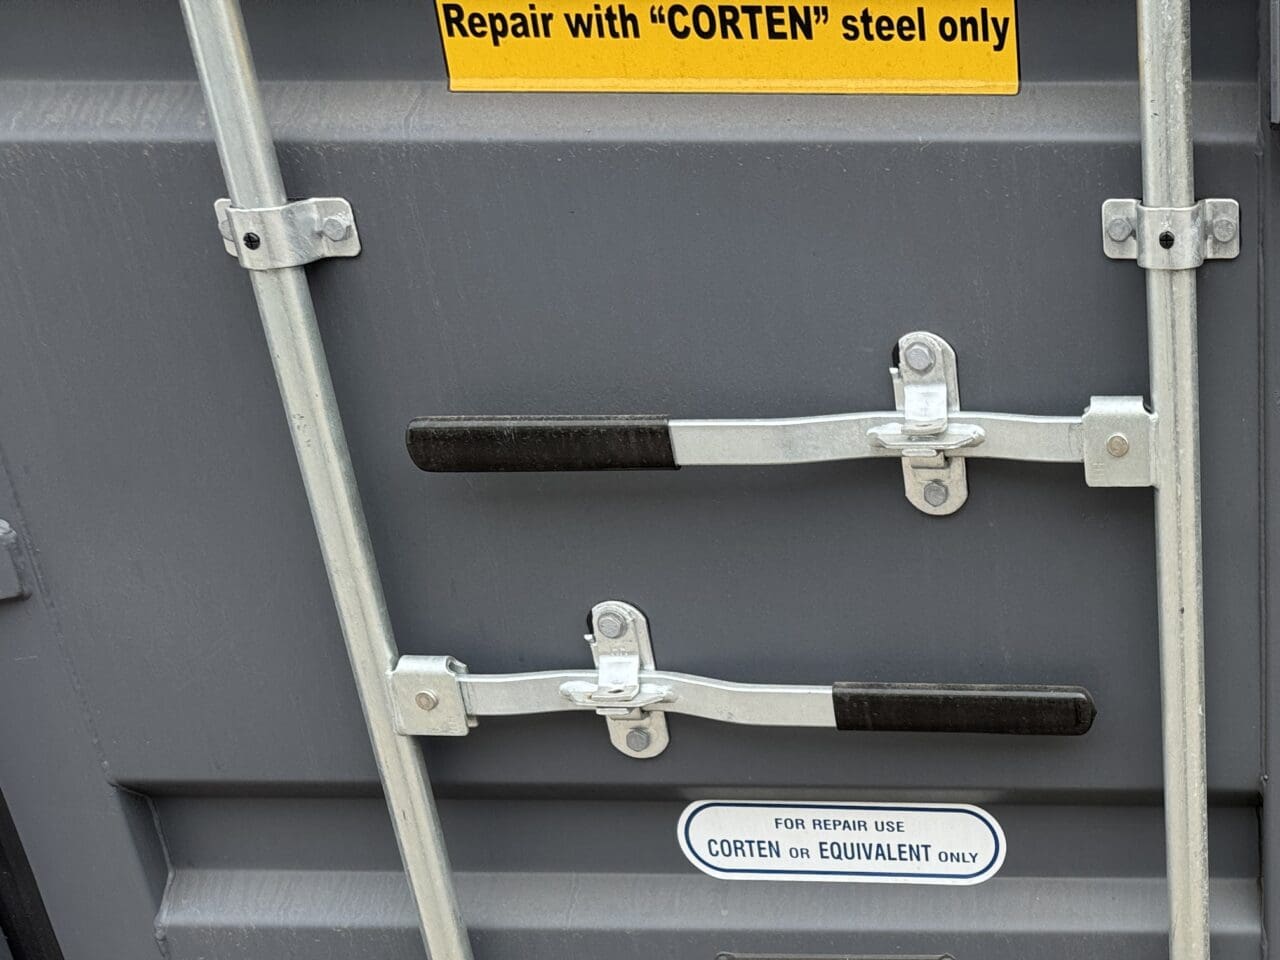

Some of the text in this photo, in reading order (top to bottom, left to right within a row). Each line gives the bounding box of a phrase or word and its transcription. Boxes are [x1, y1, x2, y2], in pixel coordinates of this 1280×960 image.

[445, 3, 554, 46] Repair
[564, 4, 641, 40] with
[842, 6, 927, 42] steel
[938, 7, 1011, 51] only
[774, 817, 906, 833] FOR REPAIR USE
[707, 838, 979, 864] CORTEN OR EQUIVALENT ONLY
